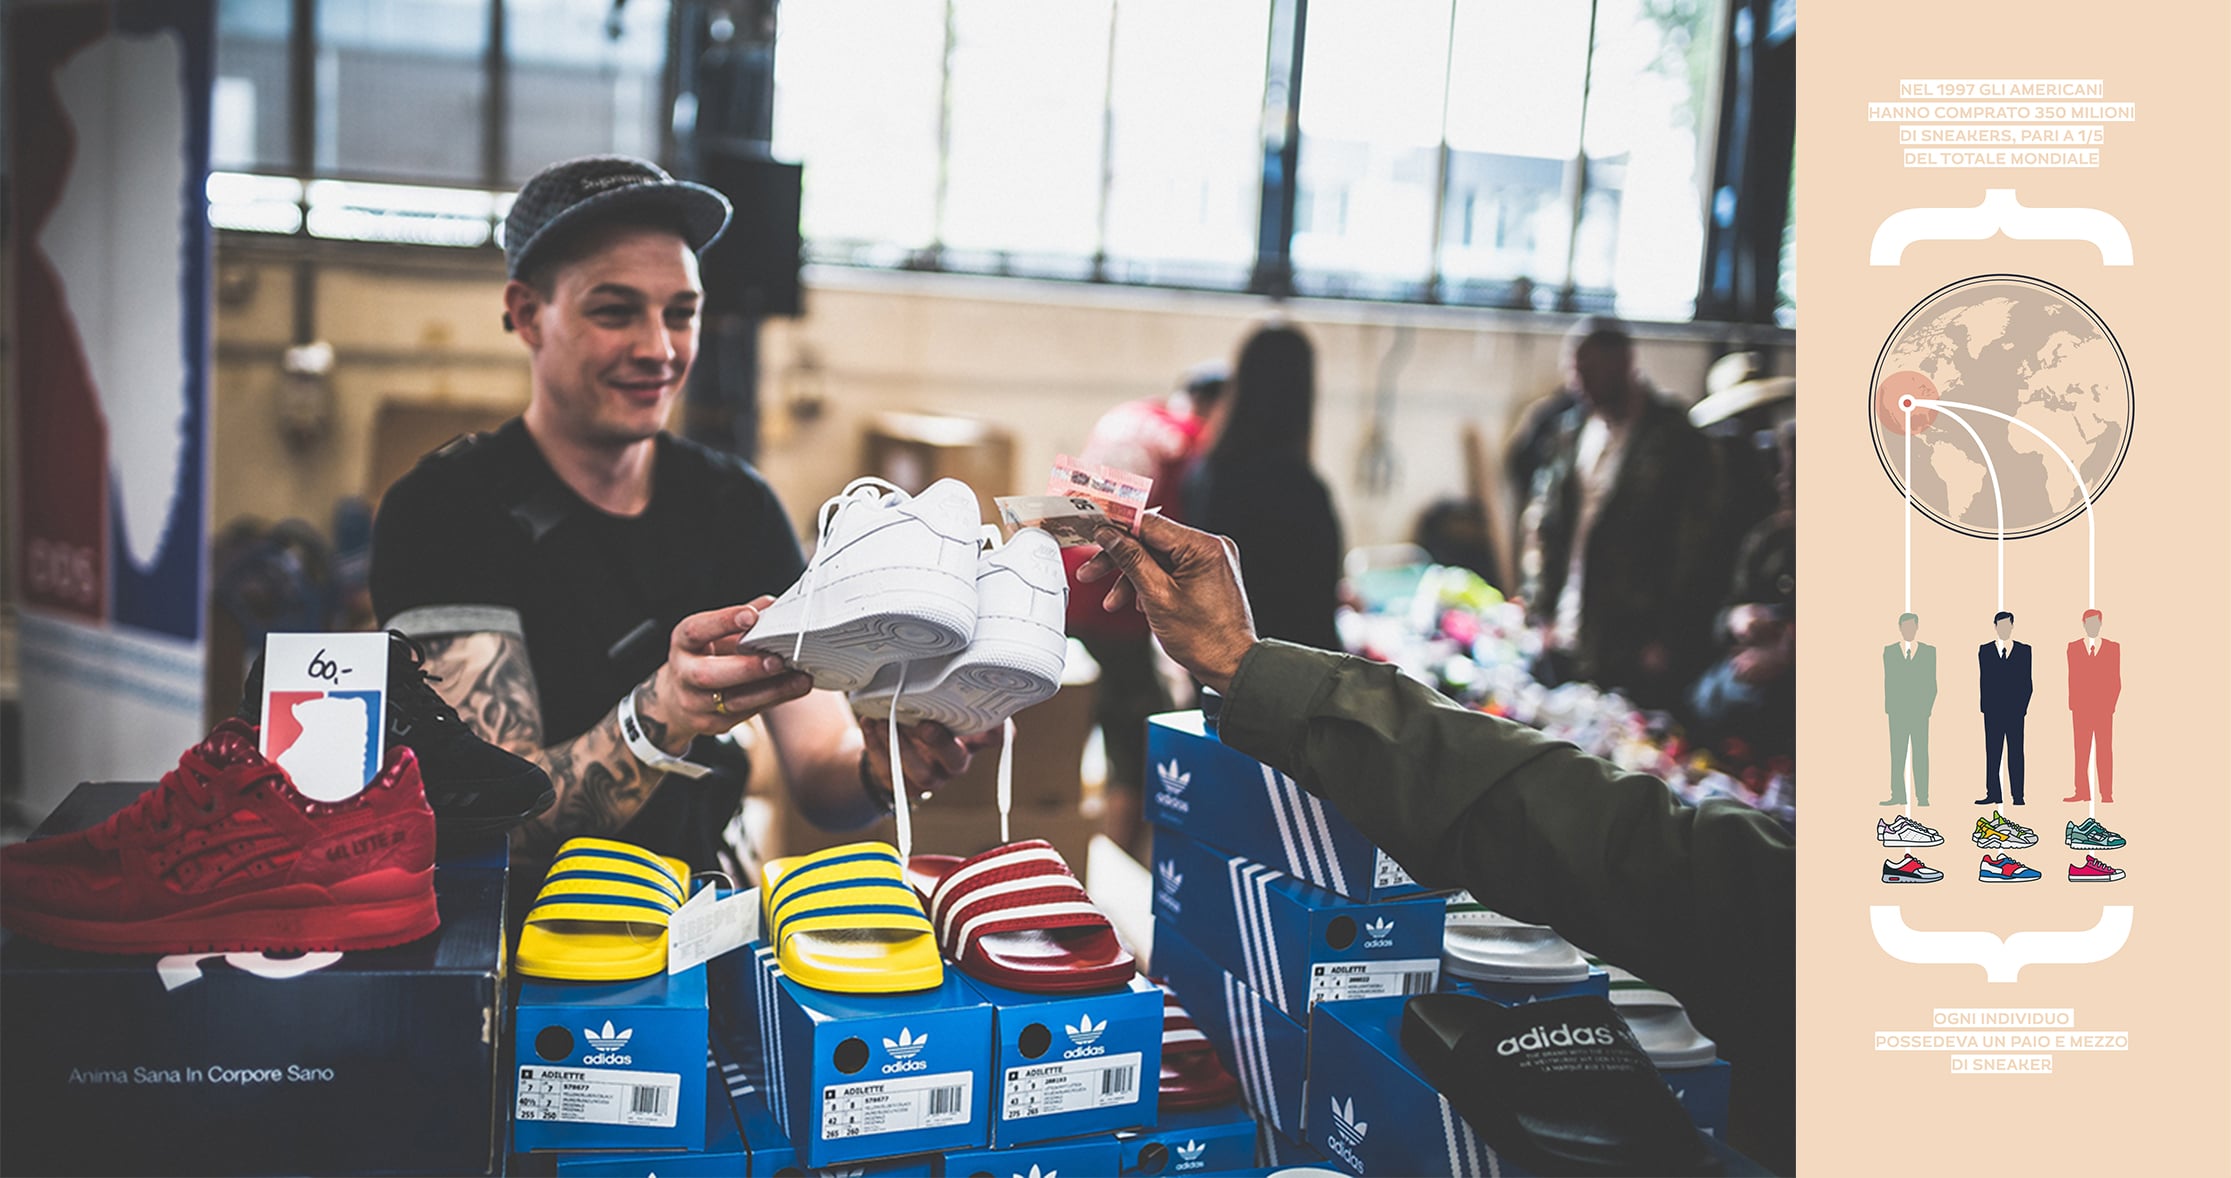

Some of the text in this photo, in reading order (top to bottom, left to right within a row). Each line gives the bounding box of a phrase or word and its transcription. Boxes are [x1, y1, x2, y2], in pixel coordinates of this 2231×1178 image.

[1363, 939, 1393, 949] adidas
[1331, 966, 1367, 974] ADILETTE
[1497, 1023, 1614, 1056] adidas
[1063, 1044, 1105, 1059] adidas
[583, 1053, 632, 1065] adidas
[881, 1060, 927, 1074] adidas
[1026, 1066, 1063, 1076] ADILETTE
[68, 1064, 334, 1086] Anima Sana In Corpore Sano
[541, 1070, 585, 1080] ADILETTE
[844, 1085, 884, 1096] ADILETTE
[1327, 1135, 1365, 1175] adidas
[1175, 1161, 1204, 1171] adidas
